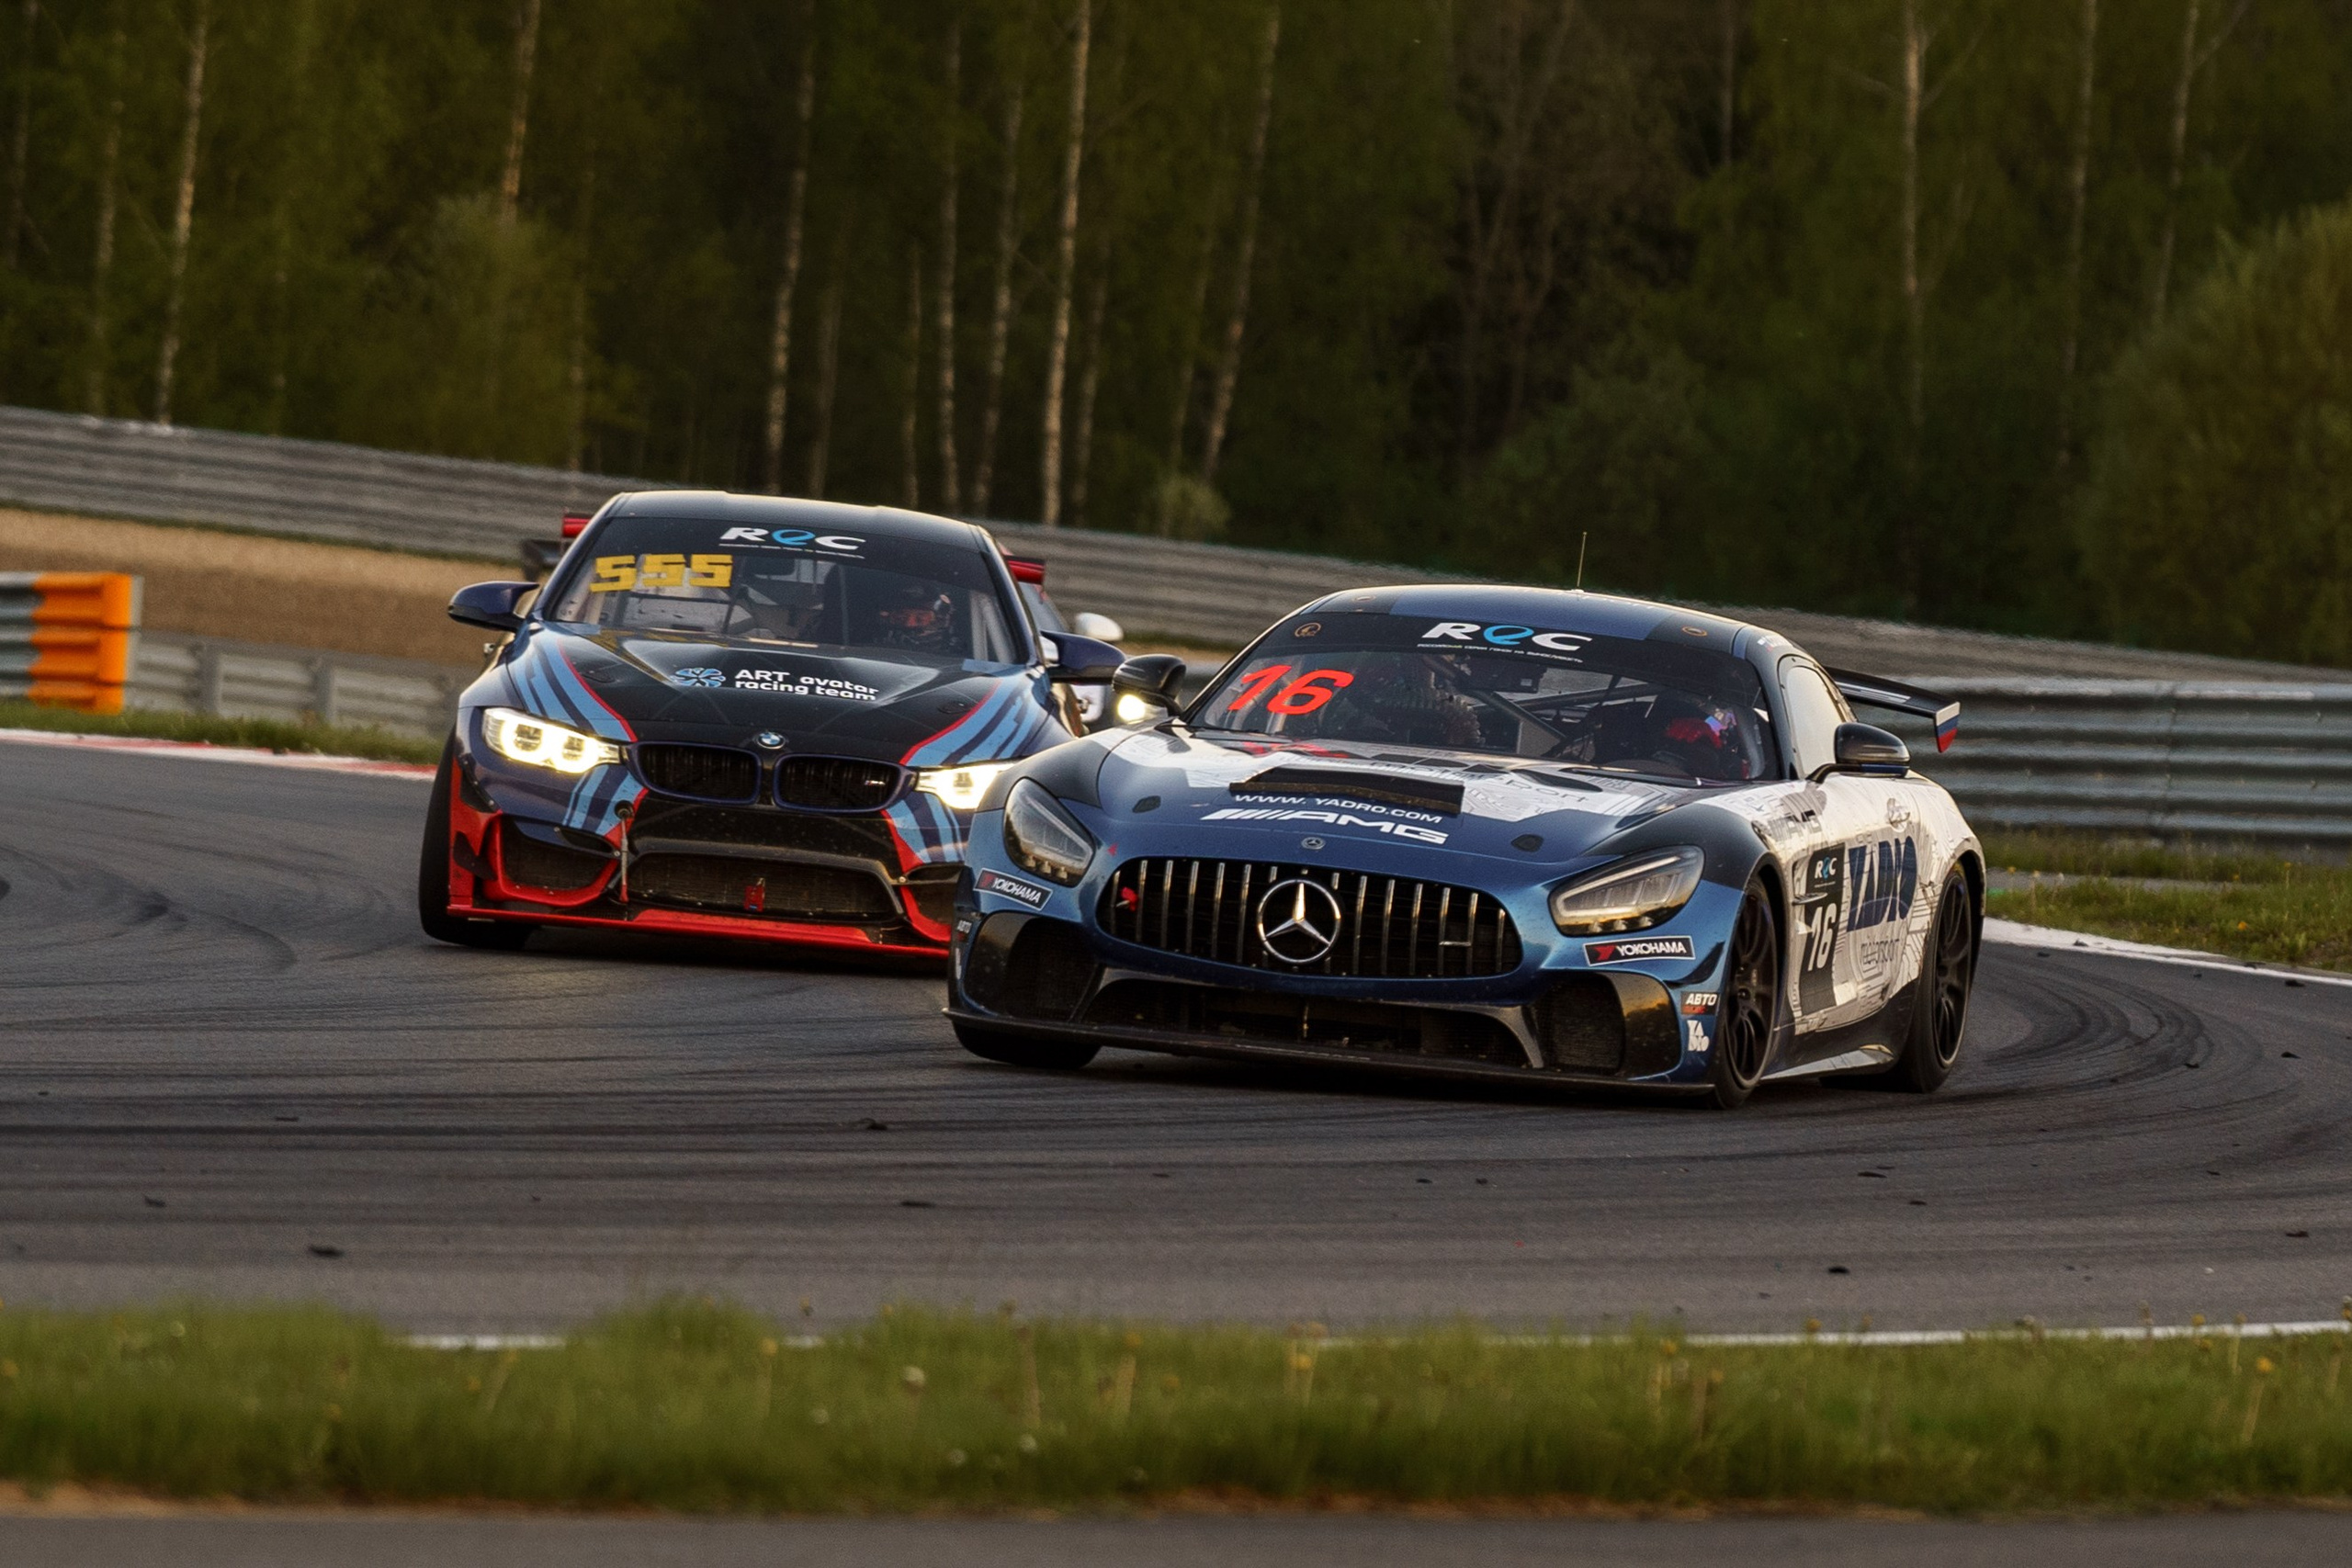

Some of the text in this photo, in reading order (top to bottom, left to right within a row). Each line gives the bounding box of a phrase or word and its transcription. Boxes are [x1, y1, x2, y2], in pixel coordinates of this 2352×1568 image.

[590, 553, 734, 592] 555
[735, 669, 879, 695] ART avatar
[735, 681, 876, 701] racing team
[1227, 664, 1354, 715] 16
[1273, 809, 1450, 844] AMG
[991, 877, 1042, 904] YOKOHAMA
[1615, 941, 1688, 958] YOKOHAMA
[1807, 902, 1838, 972] 16
